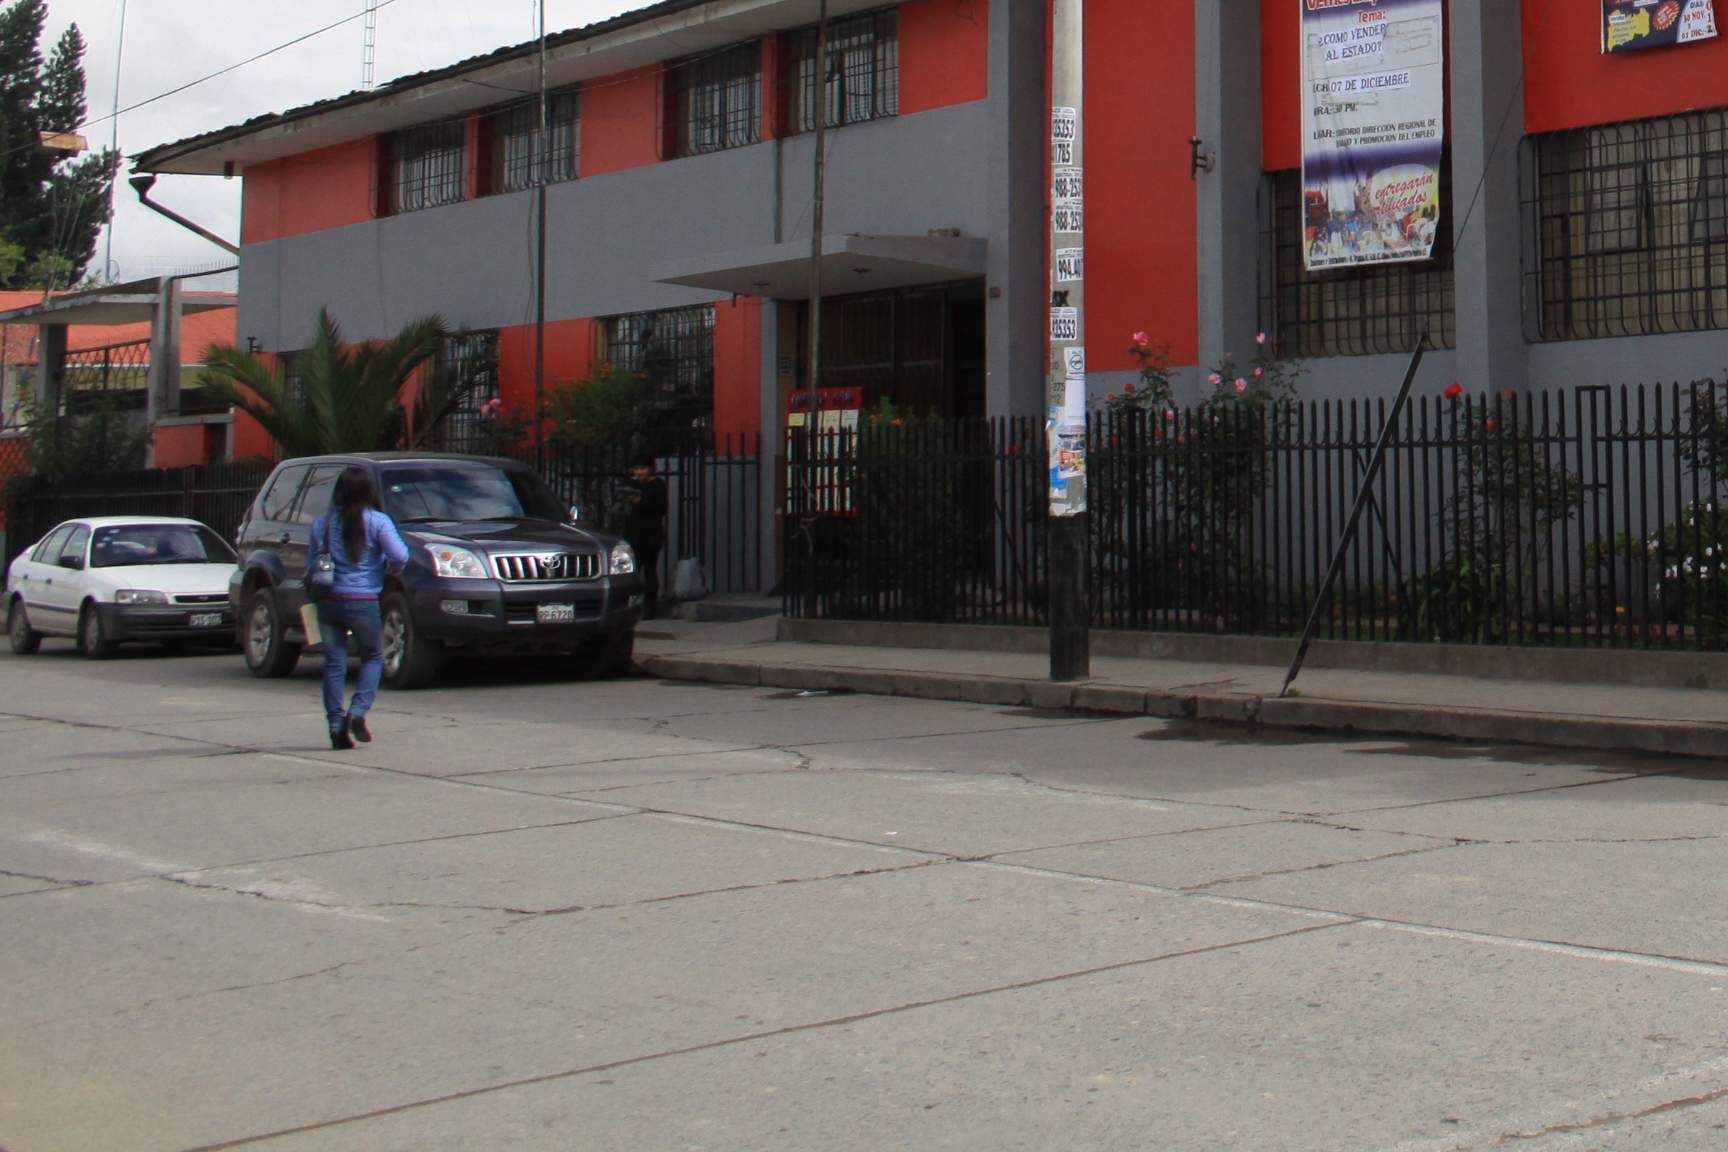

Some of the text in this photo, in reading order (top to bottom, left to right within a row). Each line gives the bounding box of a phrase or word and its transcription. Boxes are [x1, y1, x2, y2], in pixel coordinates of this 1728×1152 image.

[1358, 9, 1387, 23] Tema:
[1325, 49, 1340, 61] AL
[1330, 81, 1342, 93] 07
[1344, 79, 1357, 91] DE
[1360, 73, 1409, 89] DICIEMBRE
